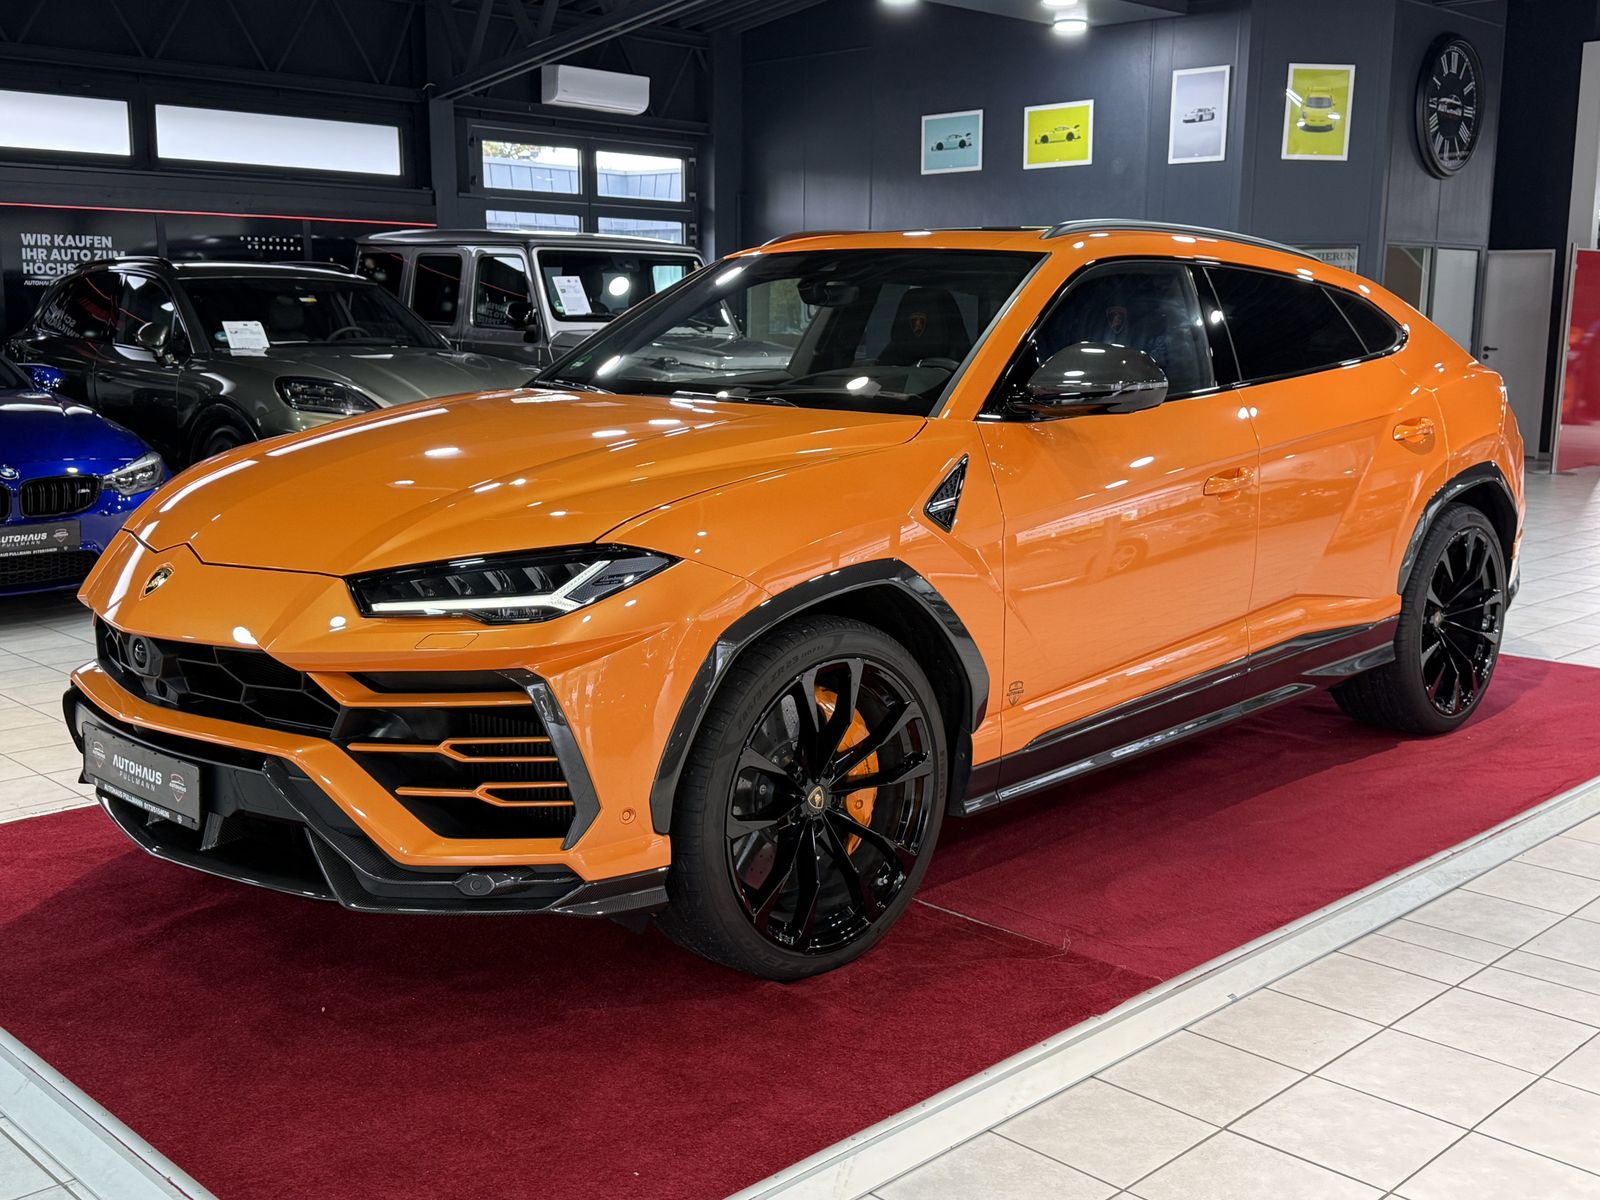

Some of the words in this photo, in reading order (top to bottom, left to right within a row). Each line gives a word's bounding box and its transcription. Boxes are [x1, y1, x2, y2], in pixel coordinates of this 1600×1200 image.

[20, 232, 51, 247] WIR
[54, 234, 113, 248] KAUFEN
[21, 247, 47, 260] IHR
[50, 249, 92, 261] AUTO
[94, 250, 126, 261] ZUM
[22, 259, 79, 275] HÖCHS
[1, 532, 48, 543] UTOHAUS
[112, 754, 163, 785] AUTOHAUS
[119, 770, 156, 792] PULLMANN
